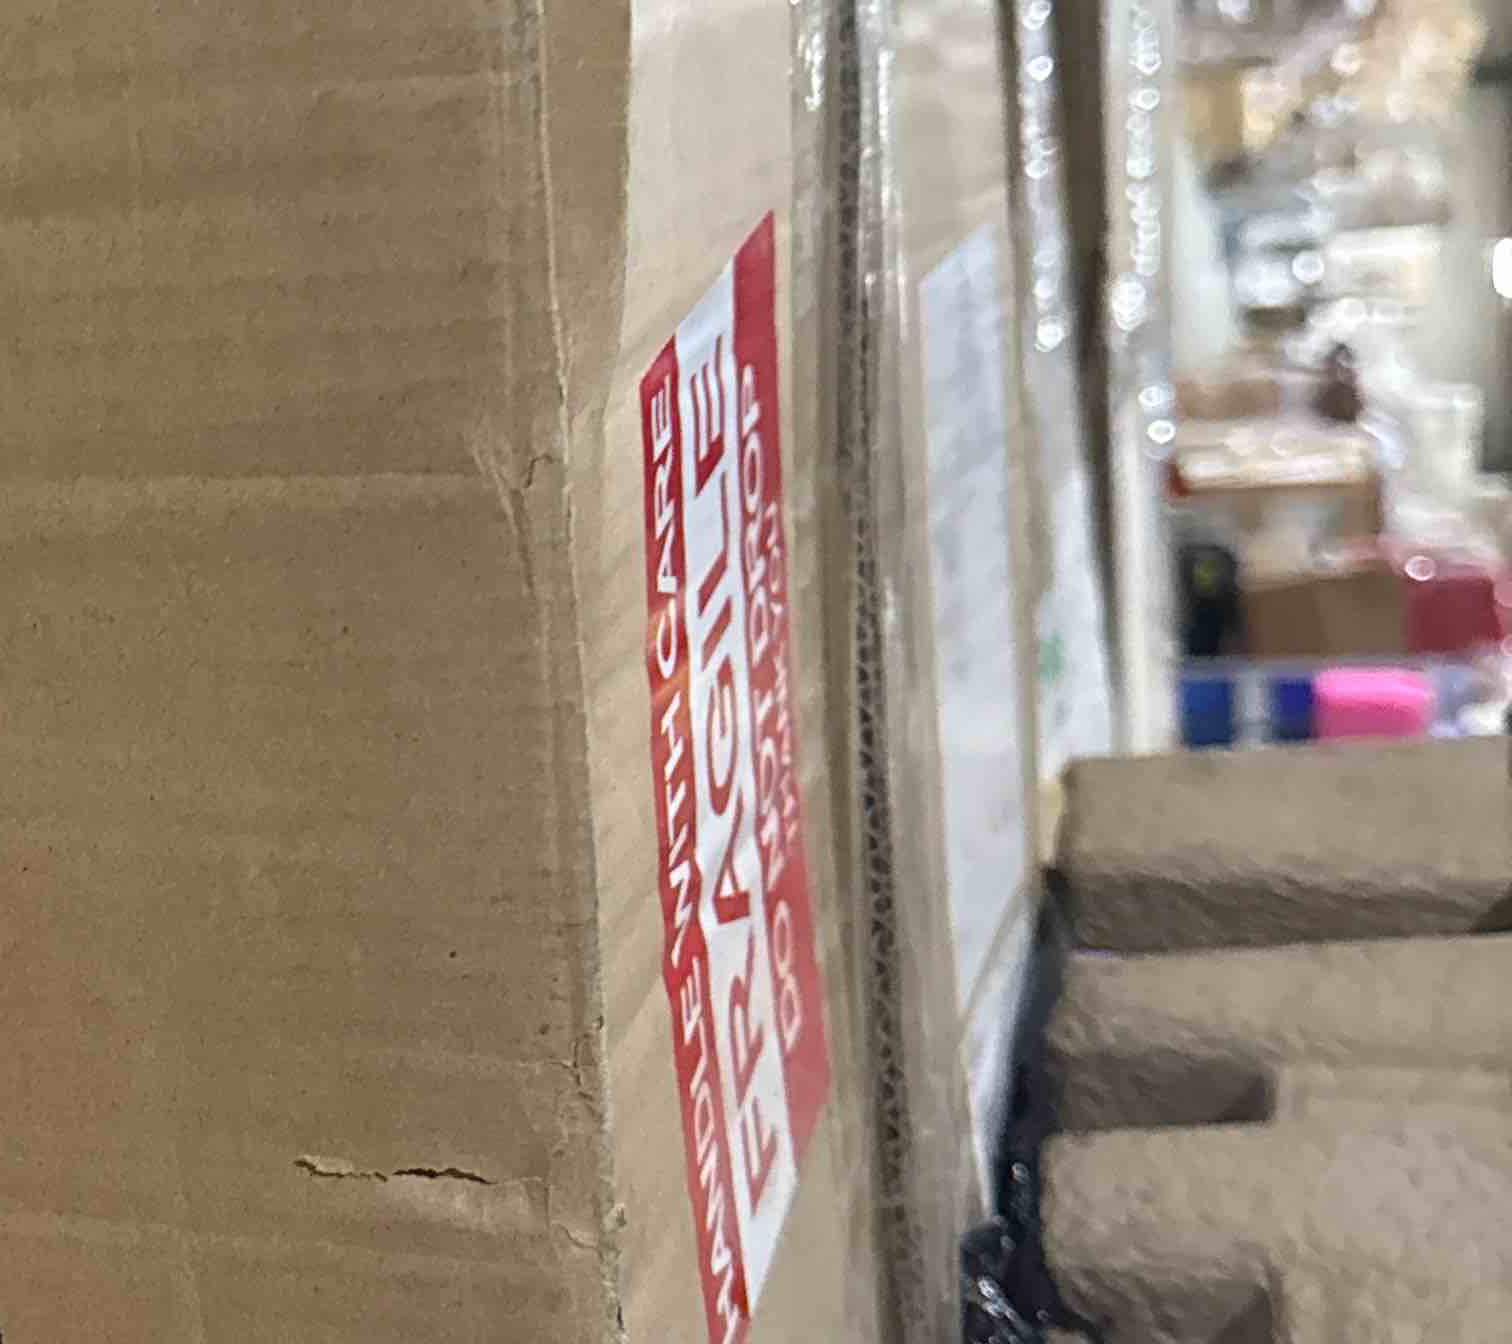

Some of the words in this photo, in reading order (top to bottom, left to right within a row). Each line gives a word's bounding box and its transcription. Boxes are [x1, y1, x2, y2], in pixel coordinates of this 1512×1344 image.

[650, 375, 680, 680] CARE
[740, 363, 768, 665] DROP
[659, 690, 695, 968] WITH
[690, 334, 777, 1216] FRAGILE
[752, 688, 787, 891] NOT
[772, 900, 804, 1053] DO
